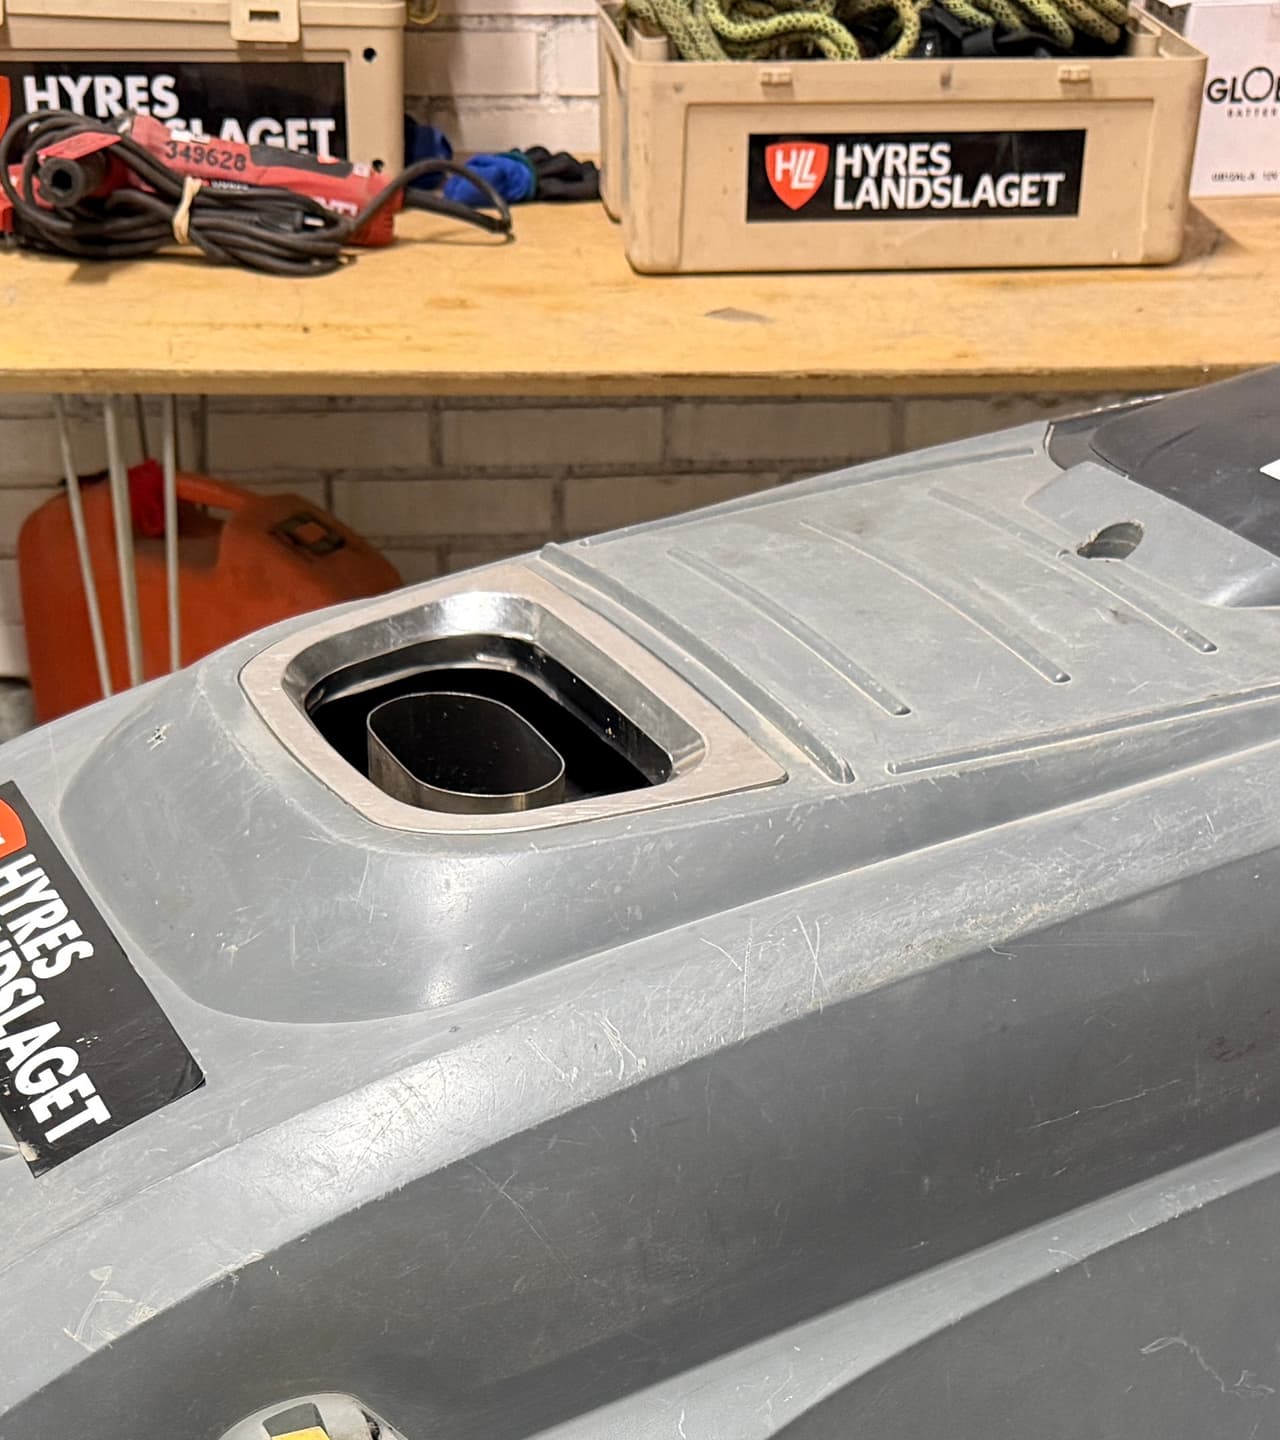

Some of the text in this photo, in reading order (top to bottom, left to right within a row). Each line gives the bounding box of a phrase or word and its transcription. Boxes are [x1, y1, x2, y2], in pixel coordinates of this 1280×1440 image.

[22, 75, 179, 118] HYRES
[165, 140, 247, 172] 349628
[774, 148, 818, 190] HLL
[835, 141, 952, 178] HYRES
[832, 172, 1066, 211] LANDSLAGET
